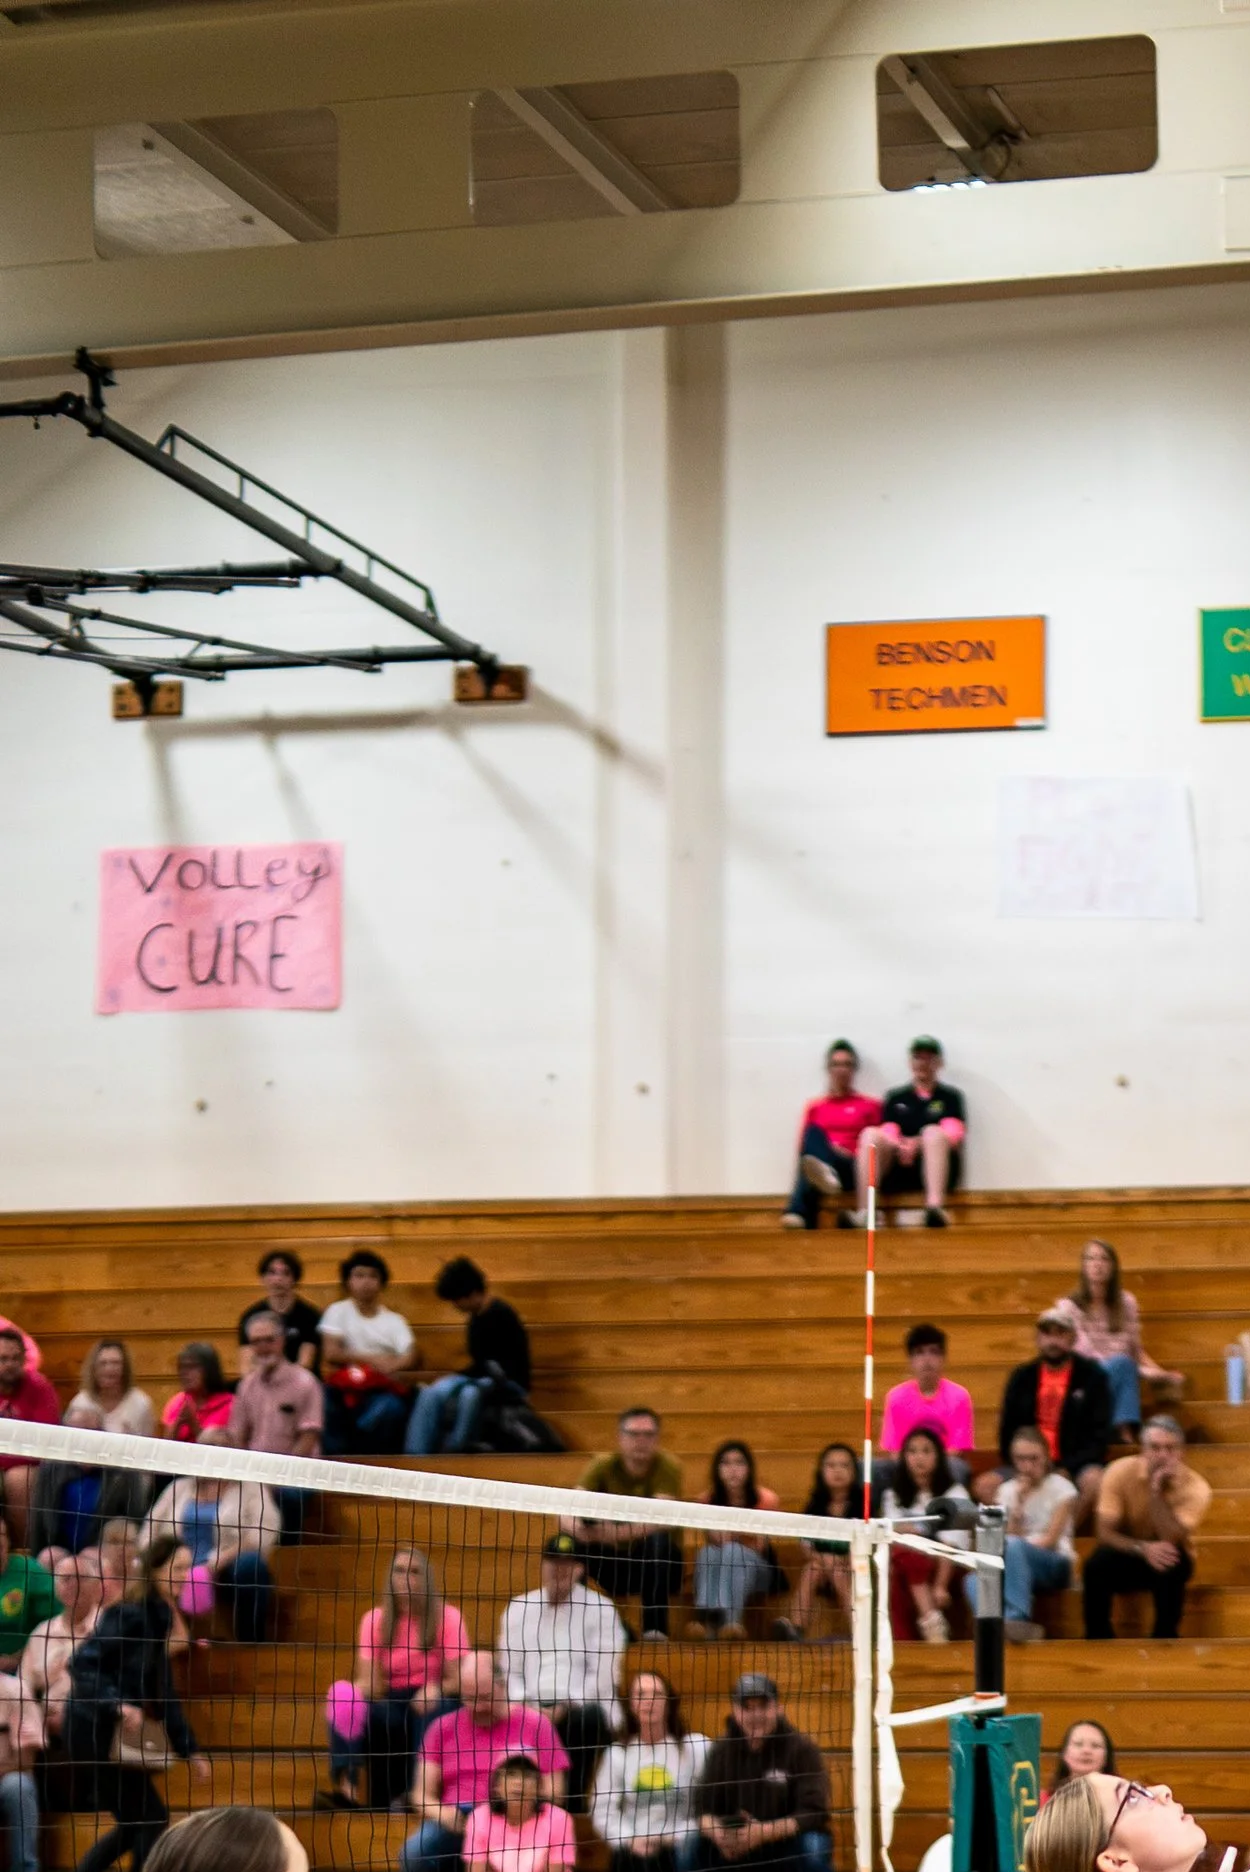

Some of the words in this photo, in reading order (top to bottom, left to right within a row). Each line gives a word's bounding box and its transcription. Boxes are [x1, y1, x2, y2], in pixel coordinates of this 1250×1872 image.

[876, 639, 996, 667] BENSON
[869, 684, 1008, 712] TECHMEN
[136, 914, 299, 994] CURE
